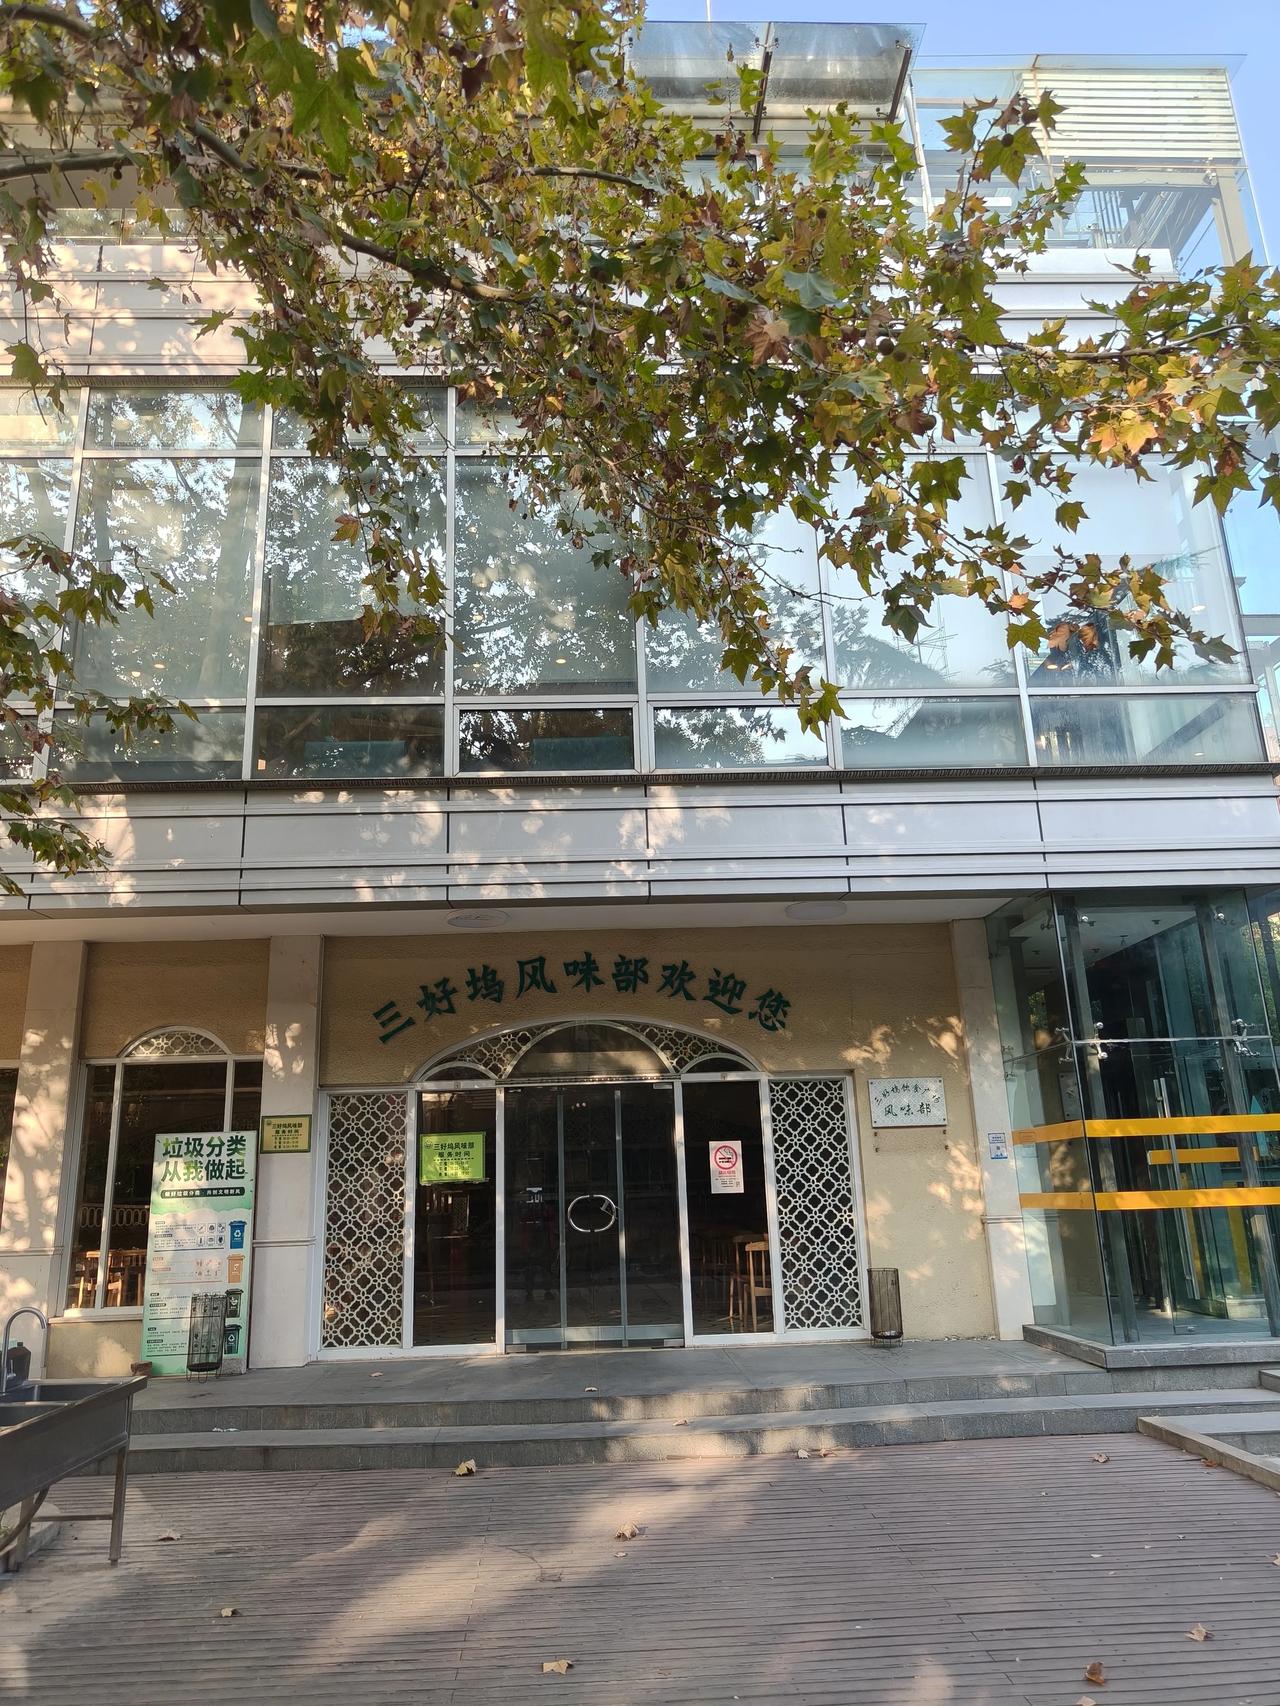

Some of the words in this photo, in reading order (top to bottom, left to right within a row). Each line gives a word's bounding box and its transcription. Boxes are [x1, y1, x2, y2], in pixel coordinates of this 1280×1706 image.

[372, 951, 791, 1044] 三好坞风味部欢迎您
[884, 1102, 931, 1116] 风味部
[162, 1135, 246, 1158] 垃圾分类
[160, 1159, 245, 1182] 从我做起
